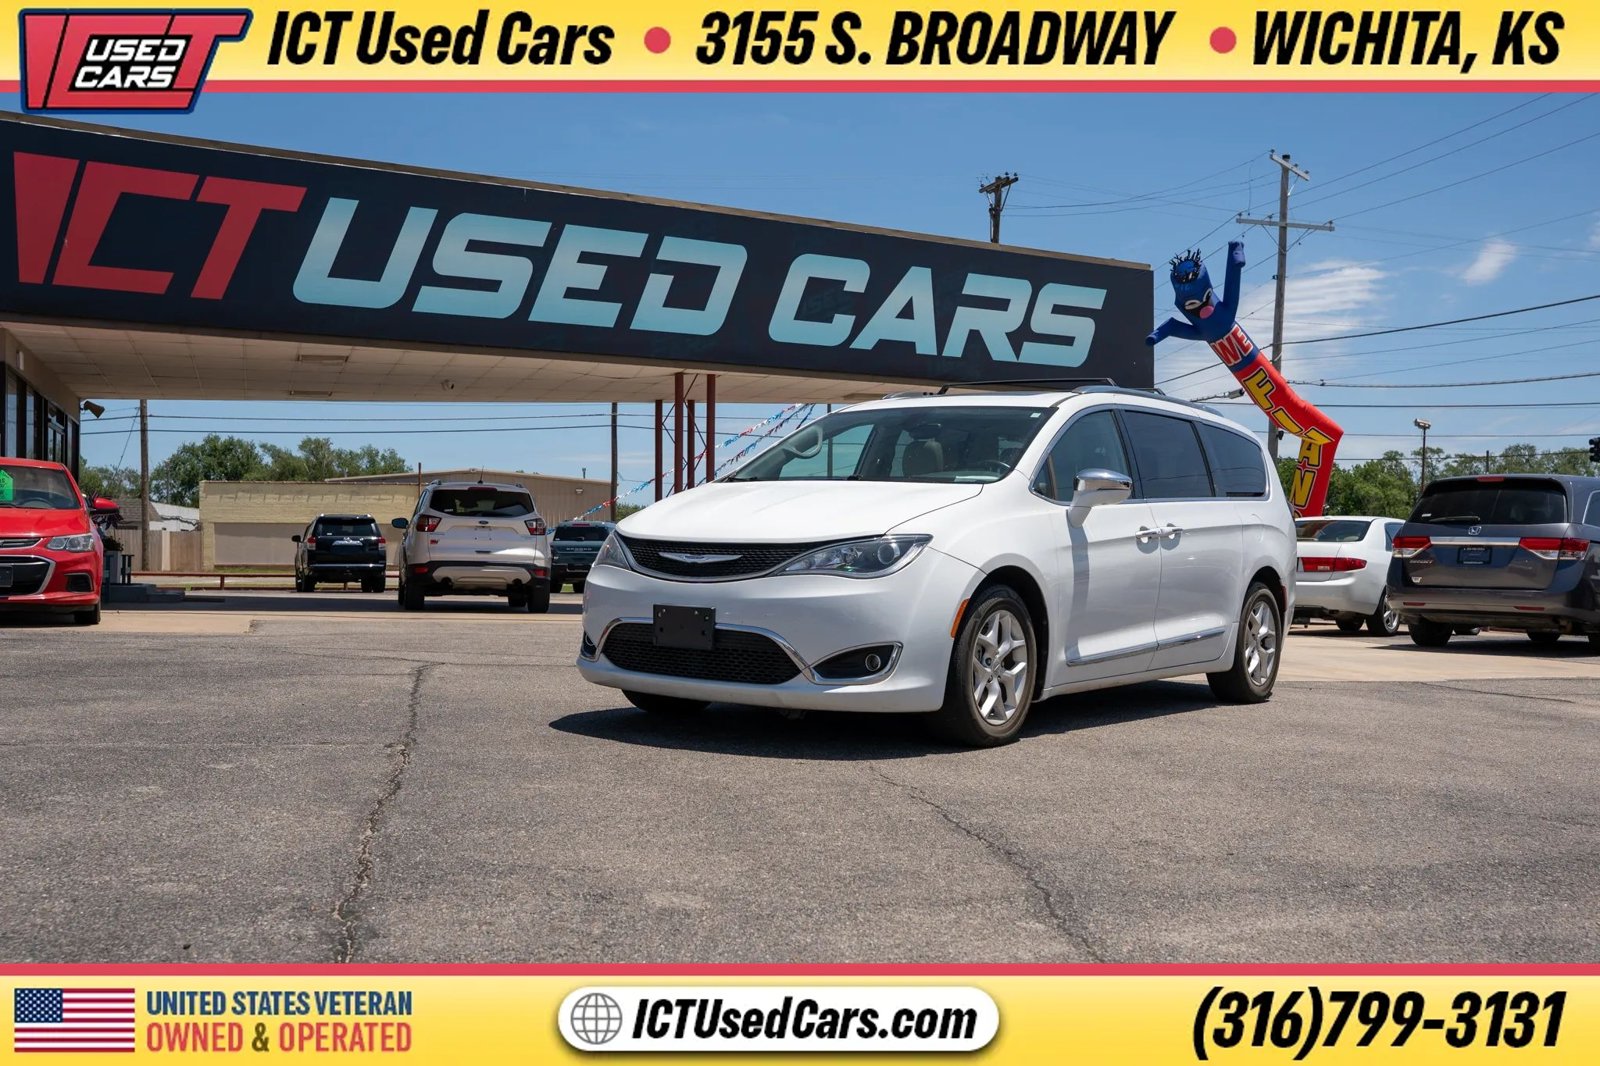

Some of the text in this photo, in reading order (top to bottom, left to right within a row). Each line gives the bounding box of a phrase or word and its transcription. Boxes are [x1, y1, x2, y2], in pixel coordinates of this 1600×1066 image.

[13, 151, 1107, 368] ICT USED CARS
[1210, 323, 1254, 367] WE
